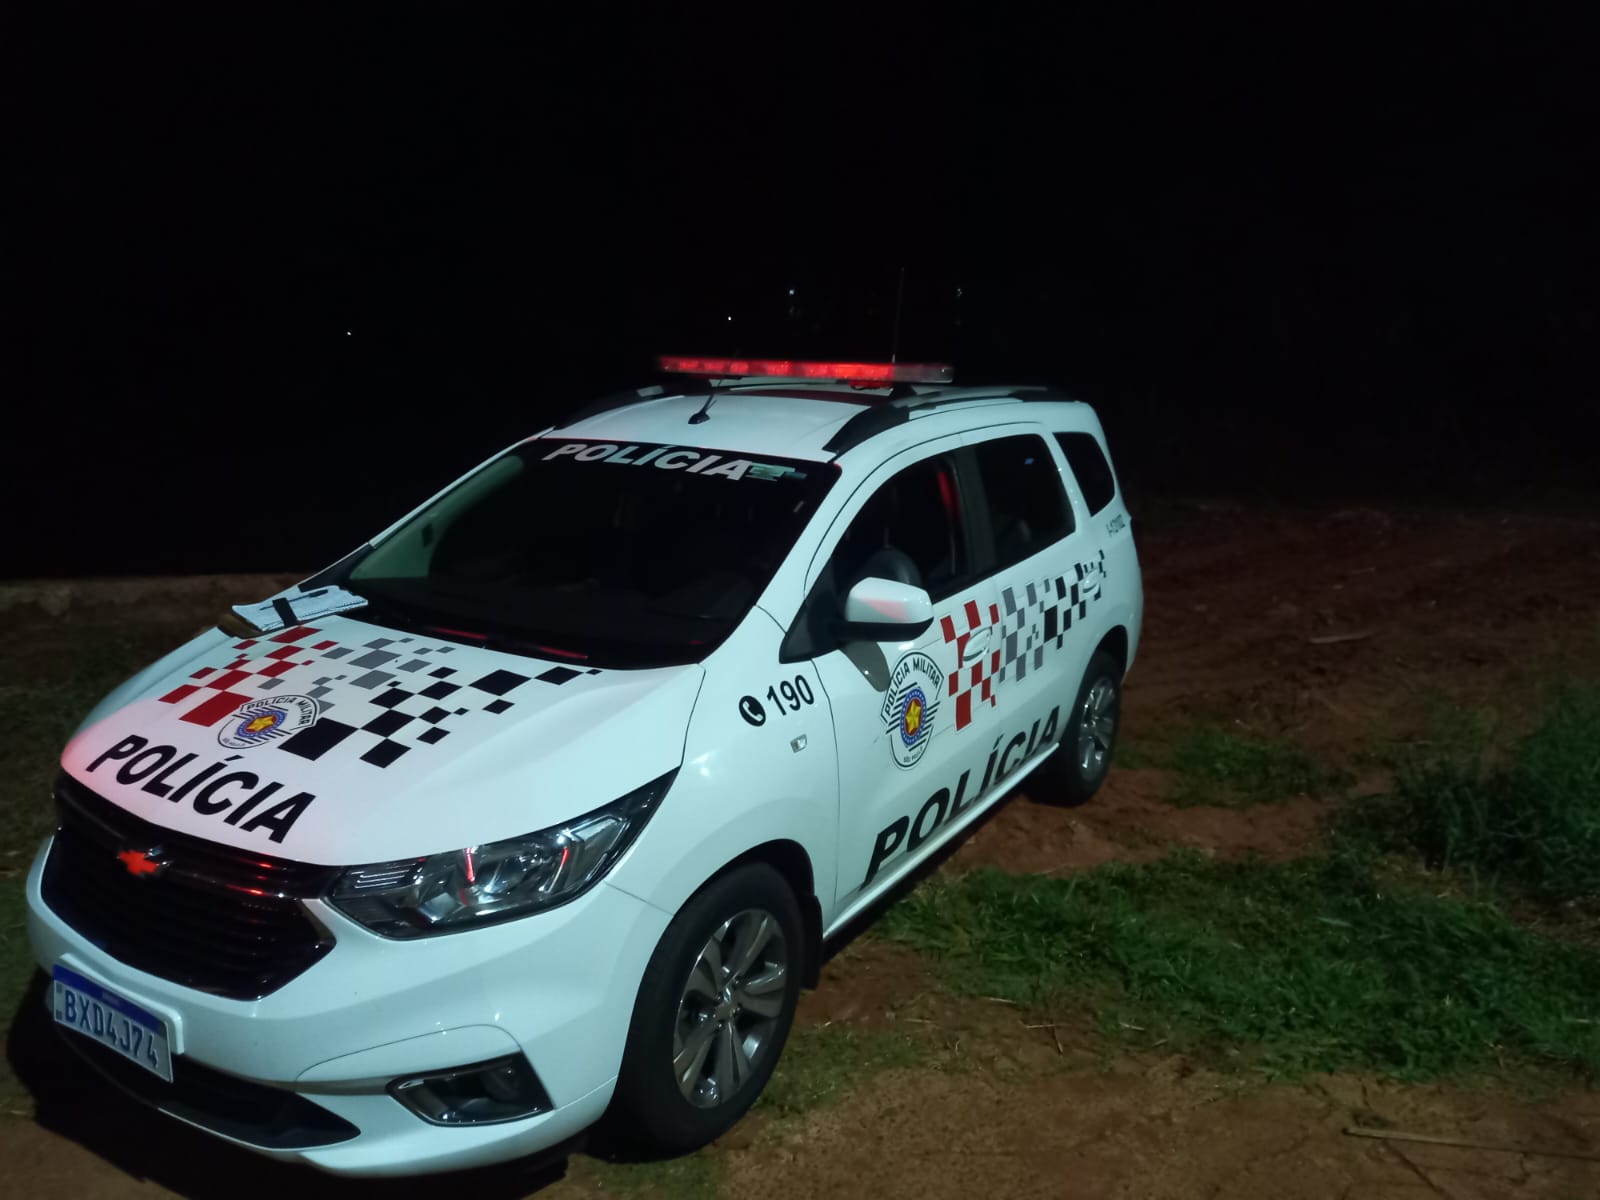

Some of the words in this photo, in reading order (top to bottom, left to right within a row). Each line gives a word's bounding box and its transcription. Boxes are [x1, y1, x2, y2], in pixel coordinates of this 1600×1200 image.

[542, 443, 751, 481] POLÍCIA
[767, 674, 815, 716] 190
[912, 657, 940, 689] MILITAR
[86, 734, 316, 844] POLÍCIA
[860, 705, 1060, 890] POLÍCIA
[65, 990, 158, 1069] BXD4J74
